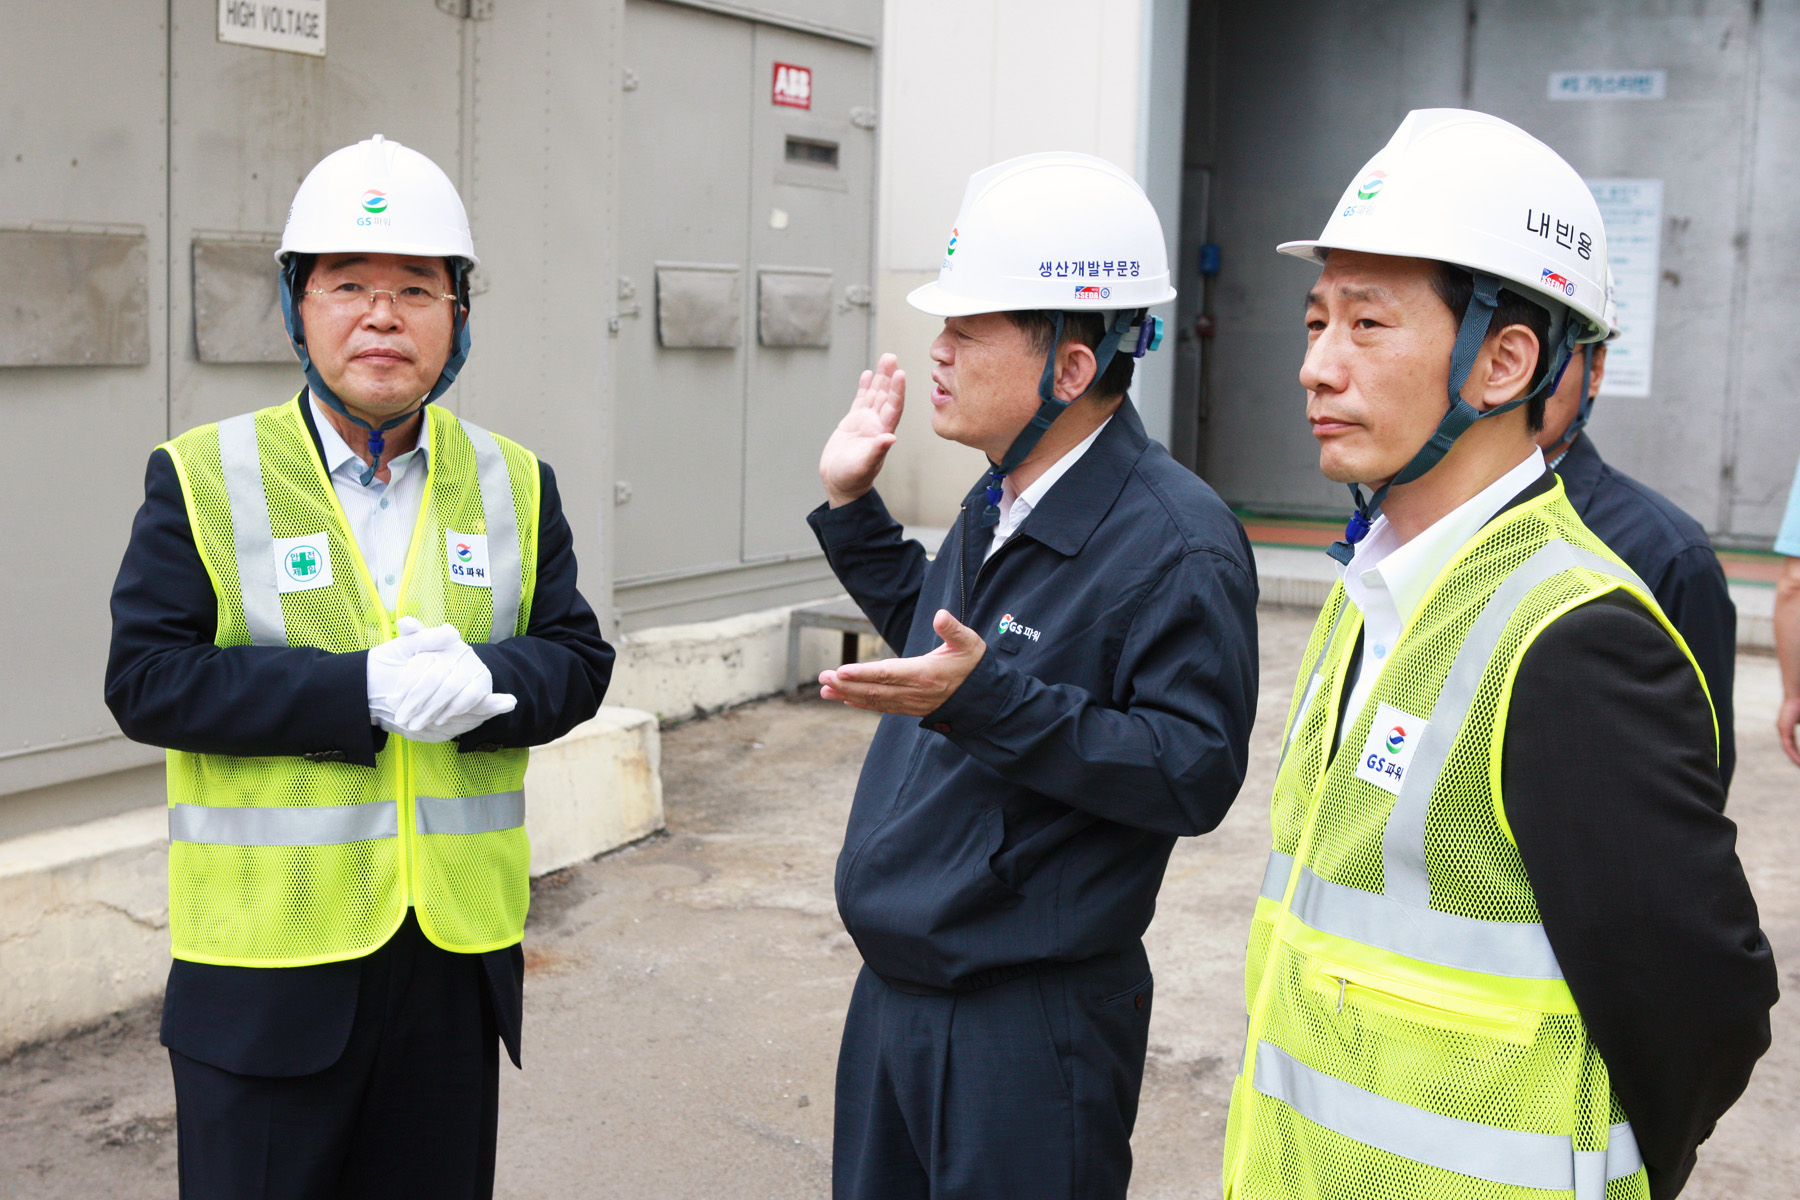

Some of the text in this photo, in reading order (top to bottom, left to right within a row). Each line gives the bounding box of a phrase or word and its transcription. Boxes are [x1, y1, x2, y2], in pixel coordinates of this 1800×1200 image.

[226, 0, 319, 39] HIGH VOLTAGE
[775, 66, 810, 98] ABB
[356, 217, 391, 227] GS 파워
[1343, 205, 1358, 217] GS
[1527, 208, 1592, 261] 내빈용
[1038, 260, 1140, 278] 생산개발부문장
[452, 563, 485, 578] GS 파워
[1009, 621, 1042, 643] GS 파워
[1366, 753, 1405, 782] GS 파워
